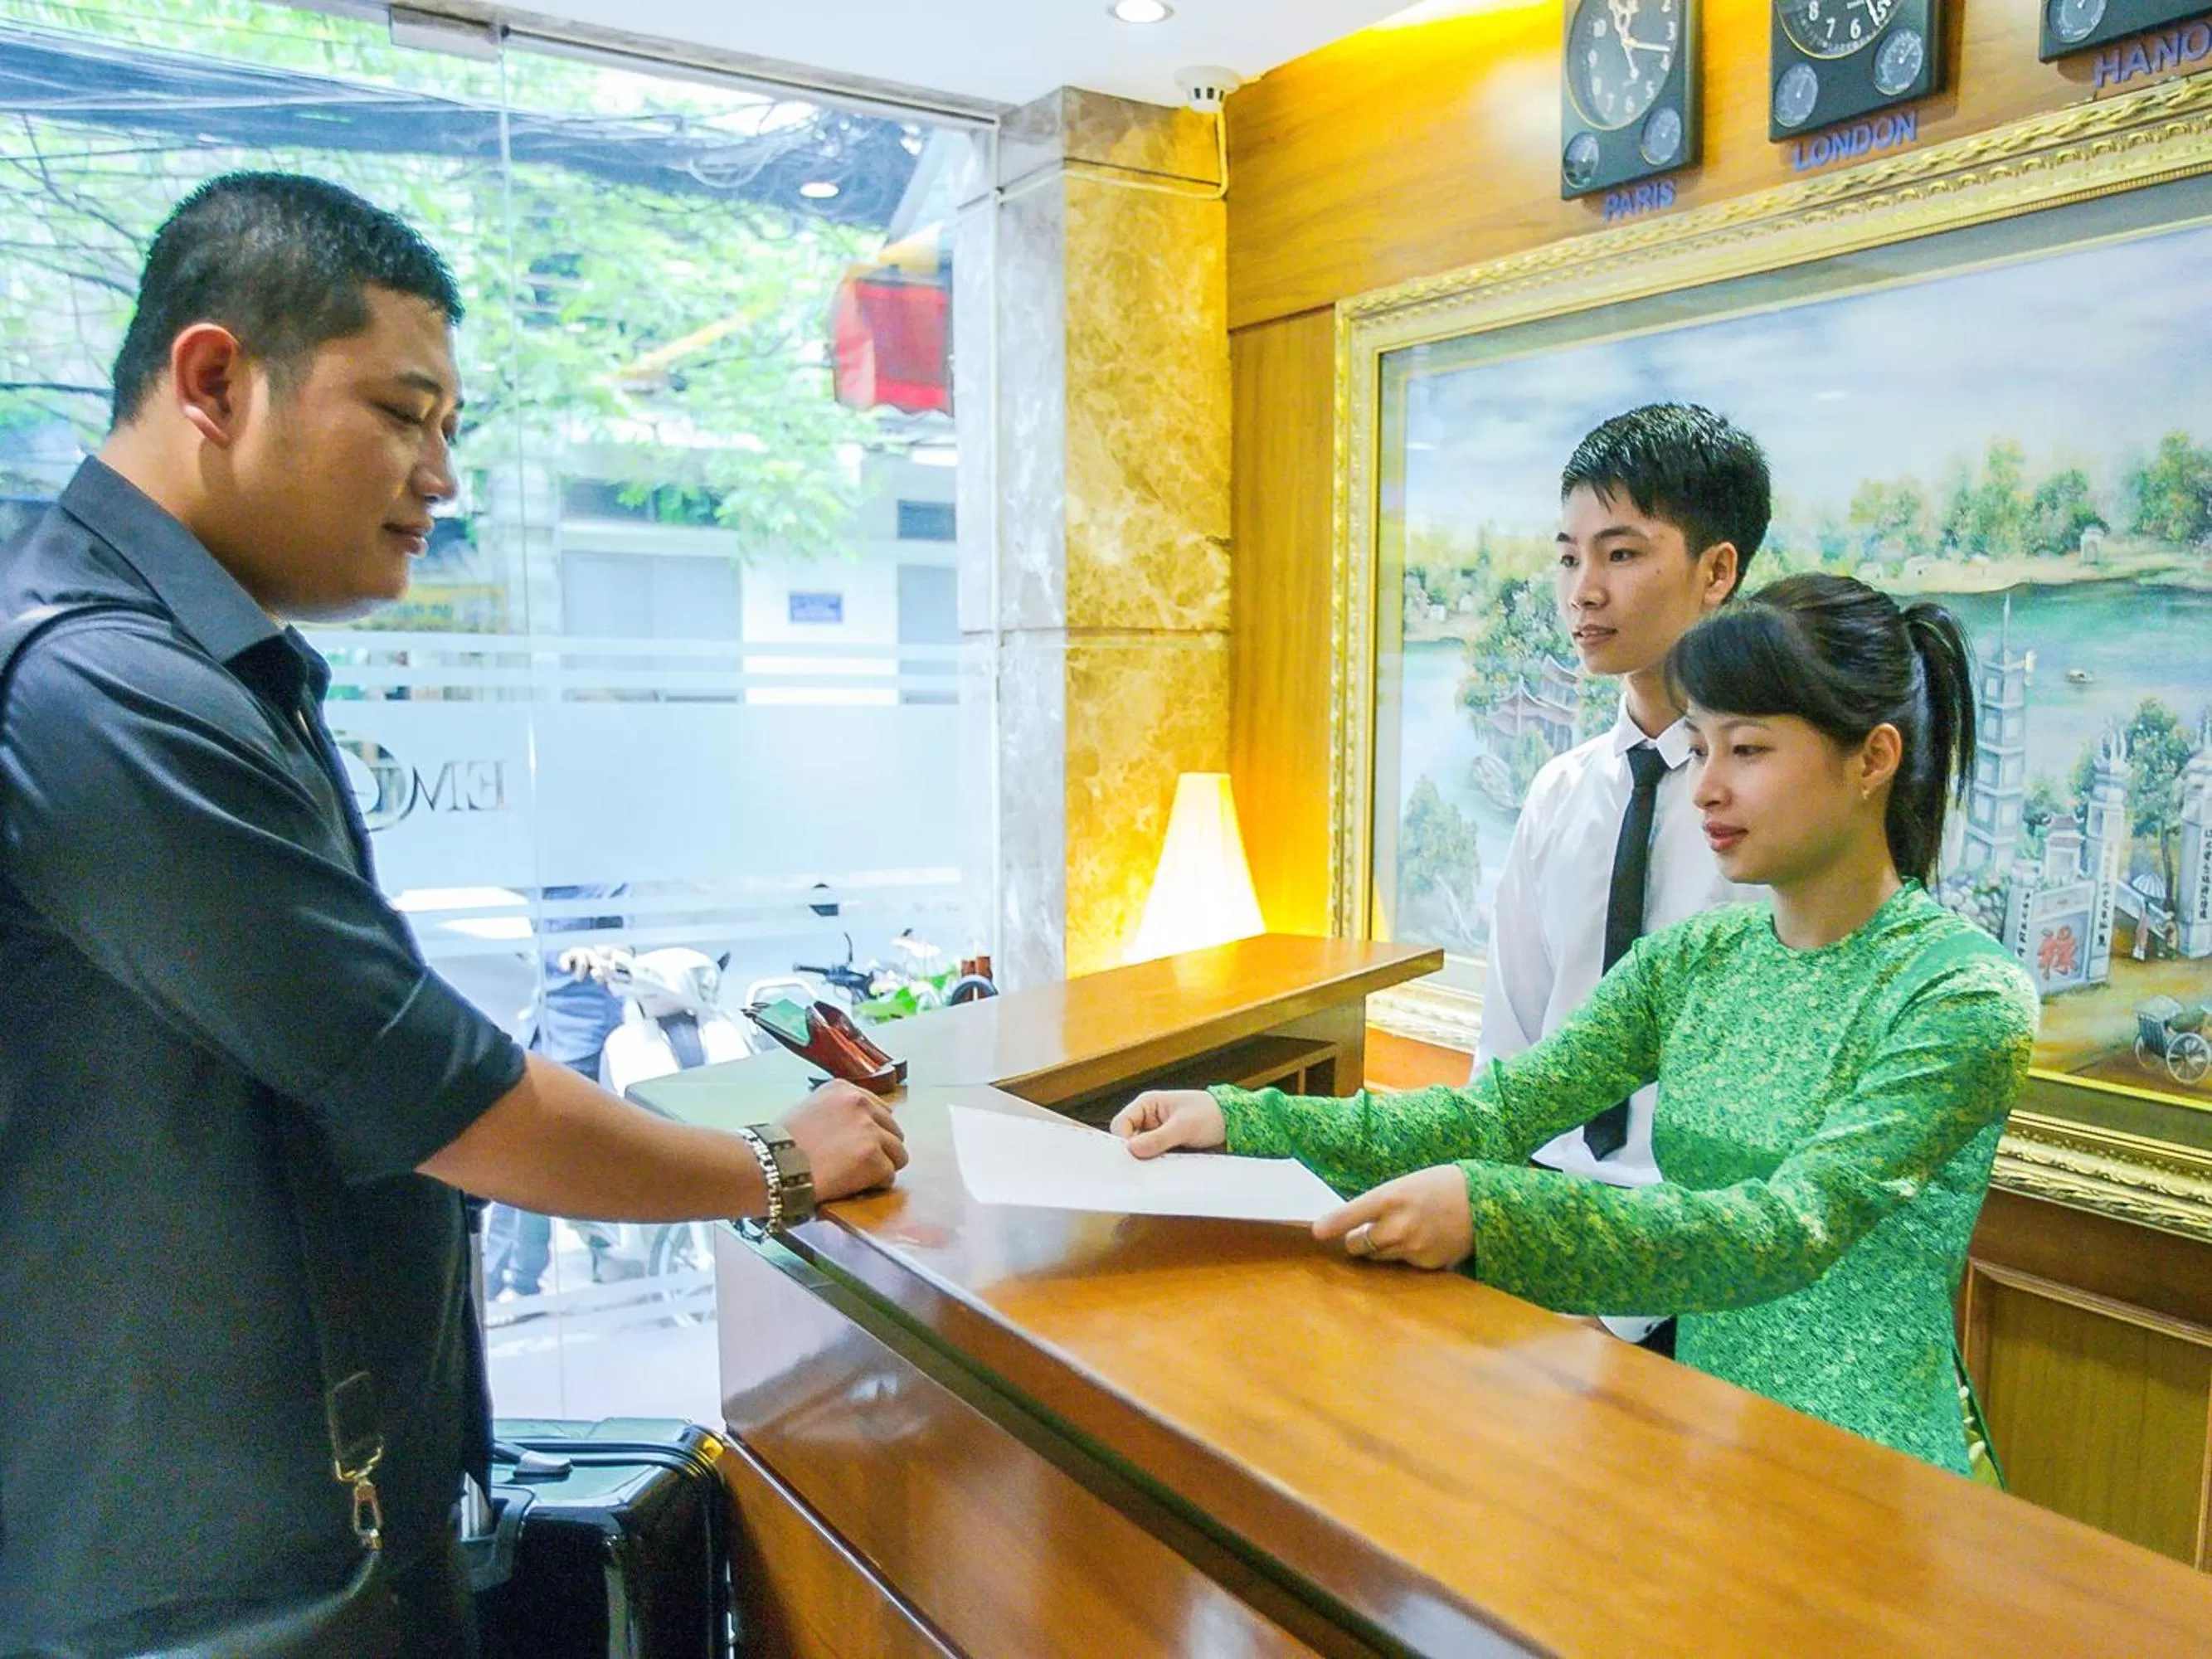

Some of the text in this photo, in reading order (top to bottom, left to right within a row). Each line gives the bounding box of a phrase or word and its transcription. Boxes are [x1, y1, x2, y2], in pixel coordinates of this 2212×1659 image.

[1826, 17, 1836, 38] 7
[1850, 17, 1861, 39] 6
[1793, 108, 1918, 173] LONDON
[1603, 178, 1676, 222] PARIS
